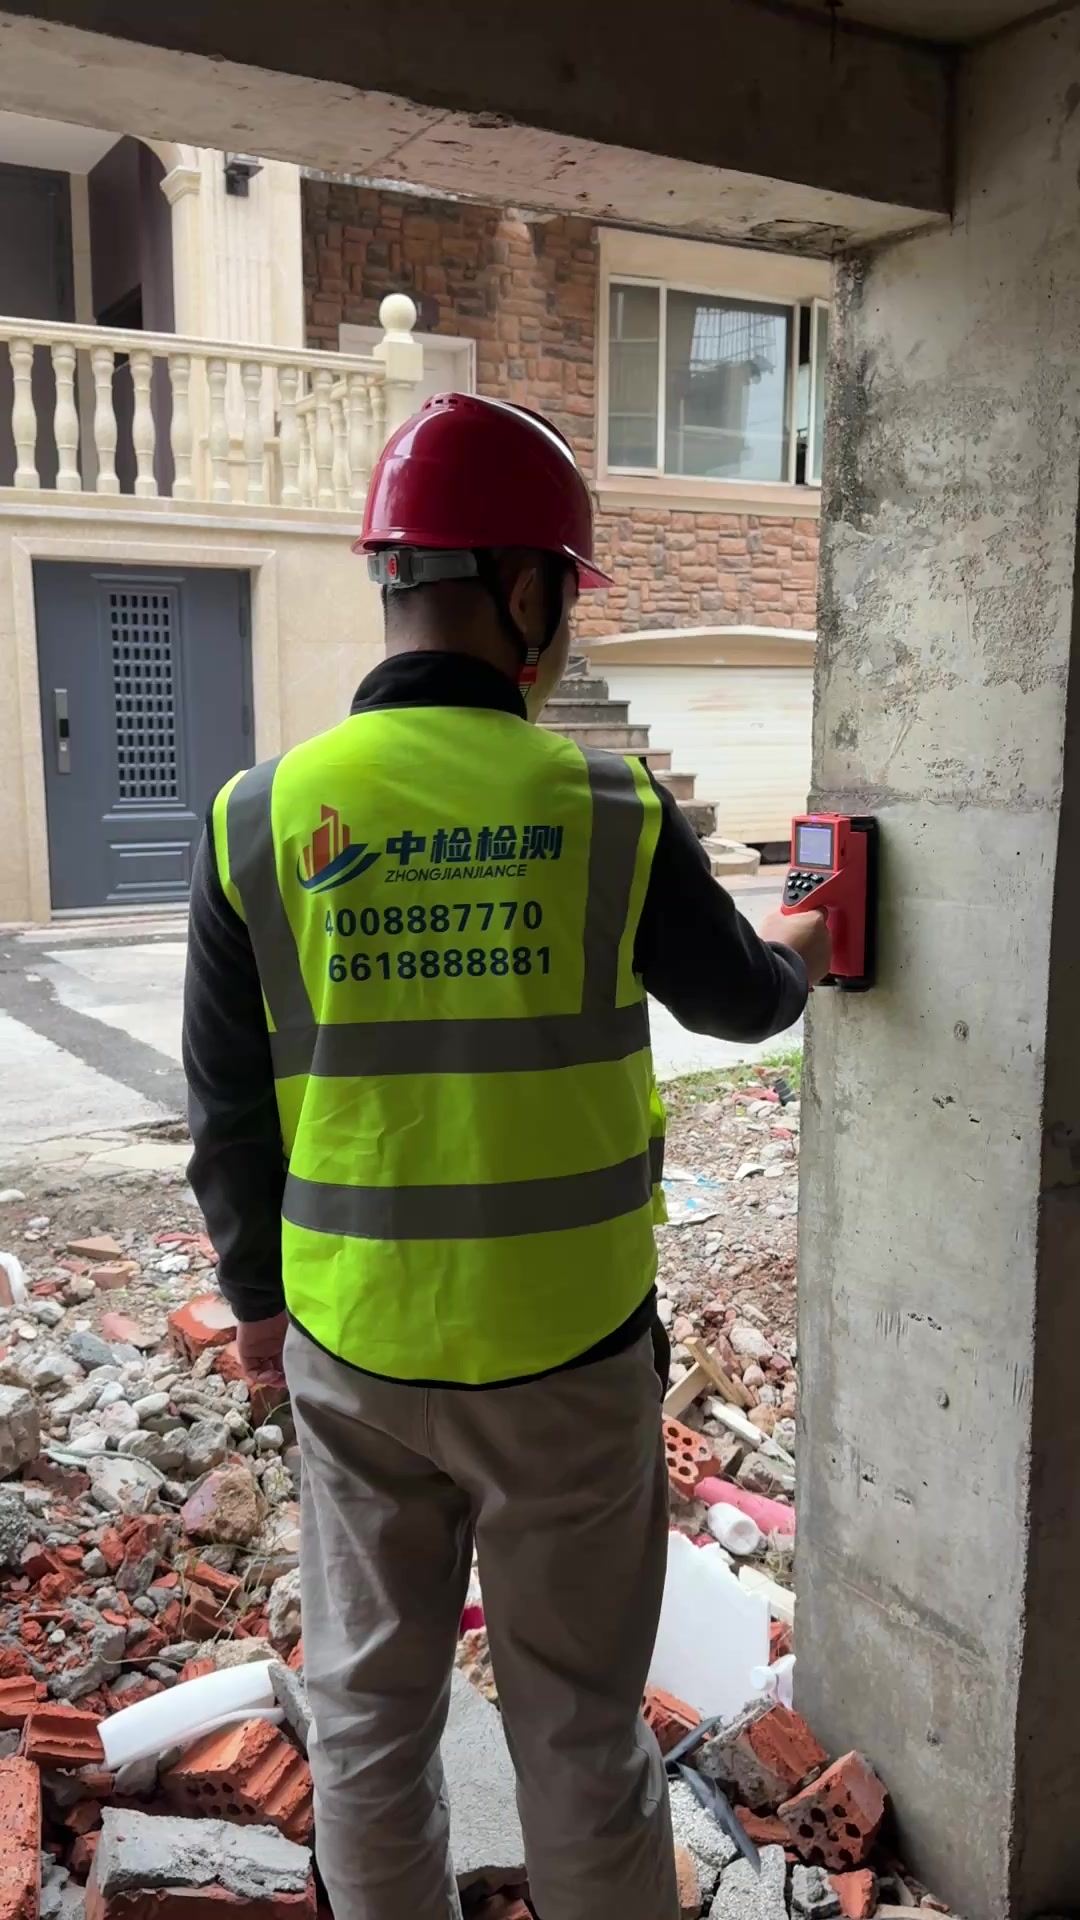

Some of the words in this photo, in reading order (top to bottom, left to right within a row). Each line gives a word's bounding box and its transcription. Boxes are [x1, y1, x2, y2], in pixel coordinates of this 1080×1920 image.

[386, 825, 564, 866] 中检检测
[384, 864, 528, 883] ZHONGJIANJIANCE
[325, 901, 543, 937] 4008887770
[328, 946, 550, 982] 6618888881
